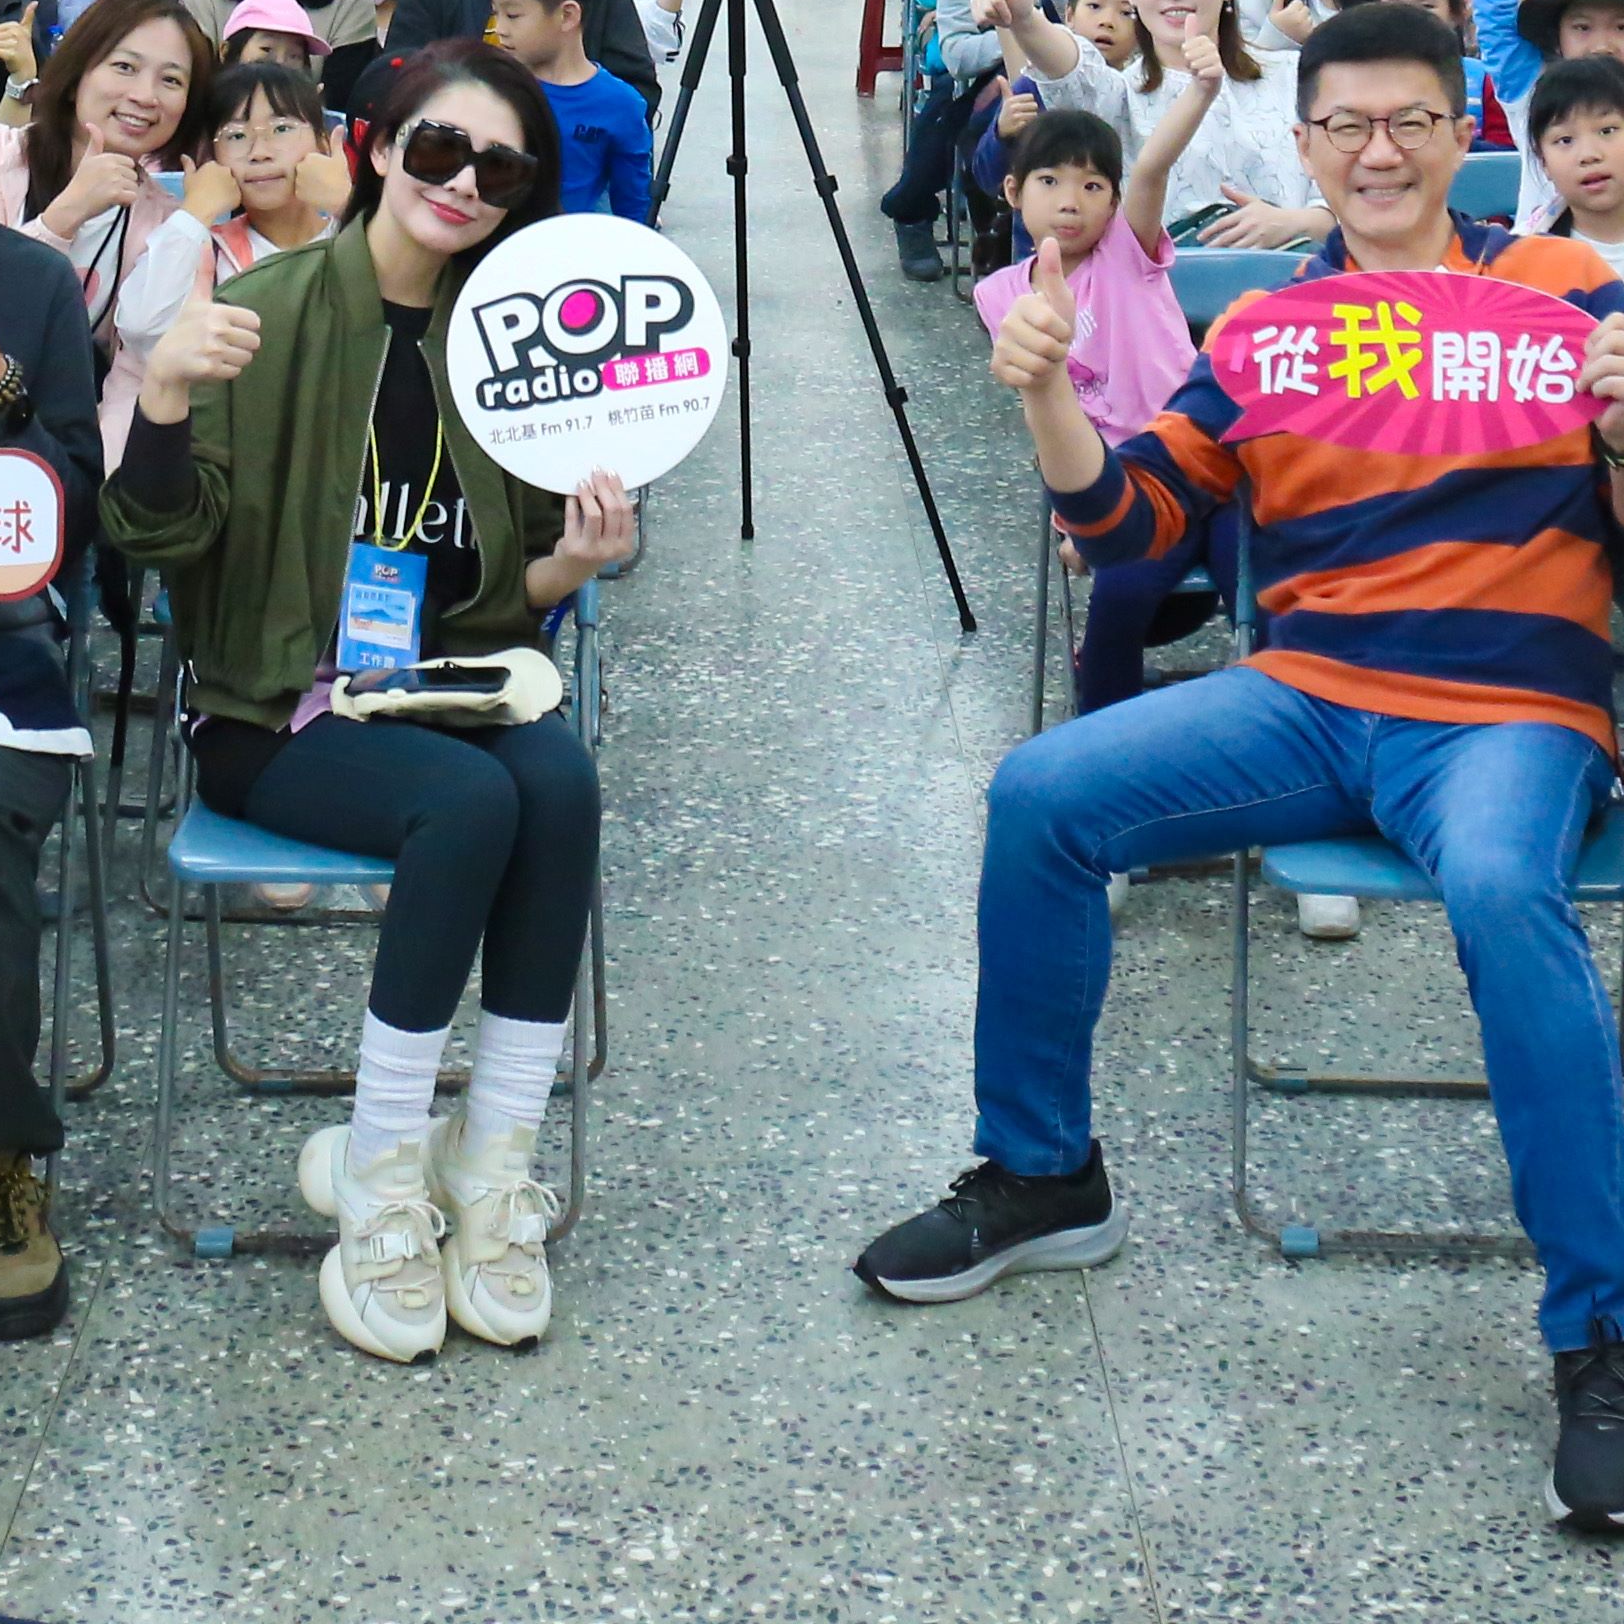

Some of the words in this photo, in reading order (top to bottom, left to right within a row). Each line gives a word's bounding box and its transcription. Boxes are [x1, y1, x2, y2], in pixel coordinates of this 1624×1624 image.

[474, 277, 692, 374] POP
[615, 352, 699, 387] 聯播網
[1253, 300, 1577, 406] 從我開始
[483, 366, 599, 407] radio
[489, 423, 537, 445] 北北基
[541, 420, 562, 437] Fm
[565, 415, 593, 431] 91.7
[608, 405, 655, 426] 桃竹苗
[659, 403, 680, 418] Fm
[683, 396, 710, 412] 90.7
